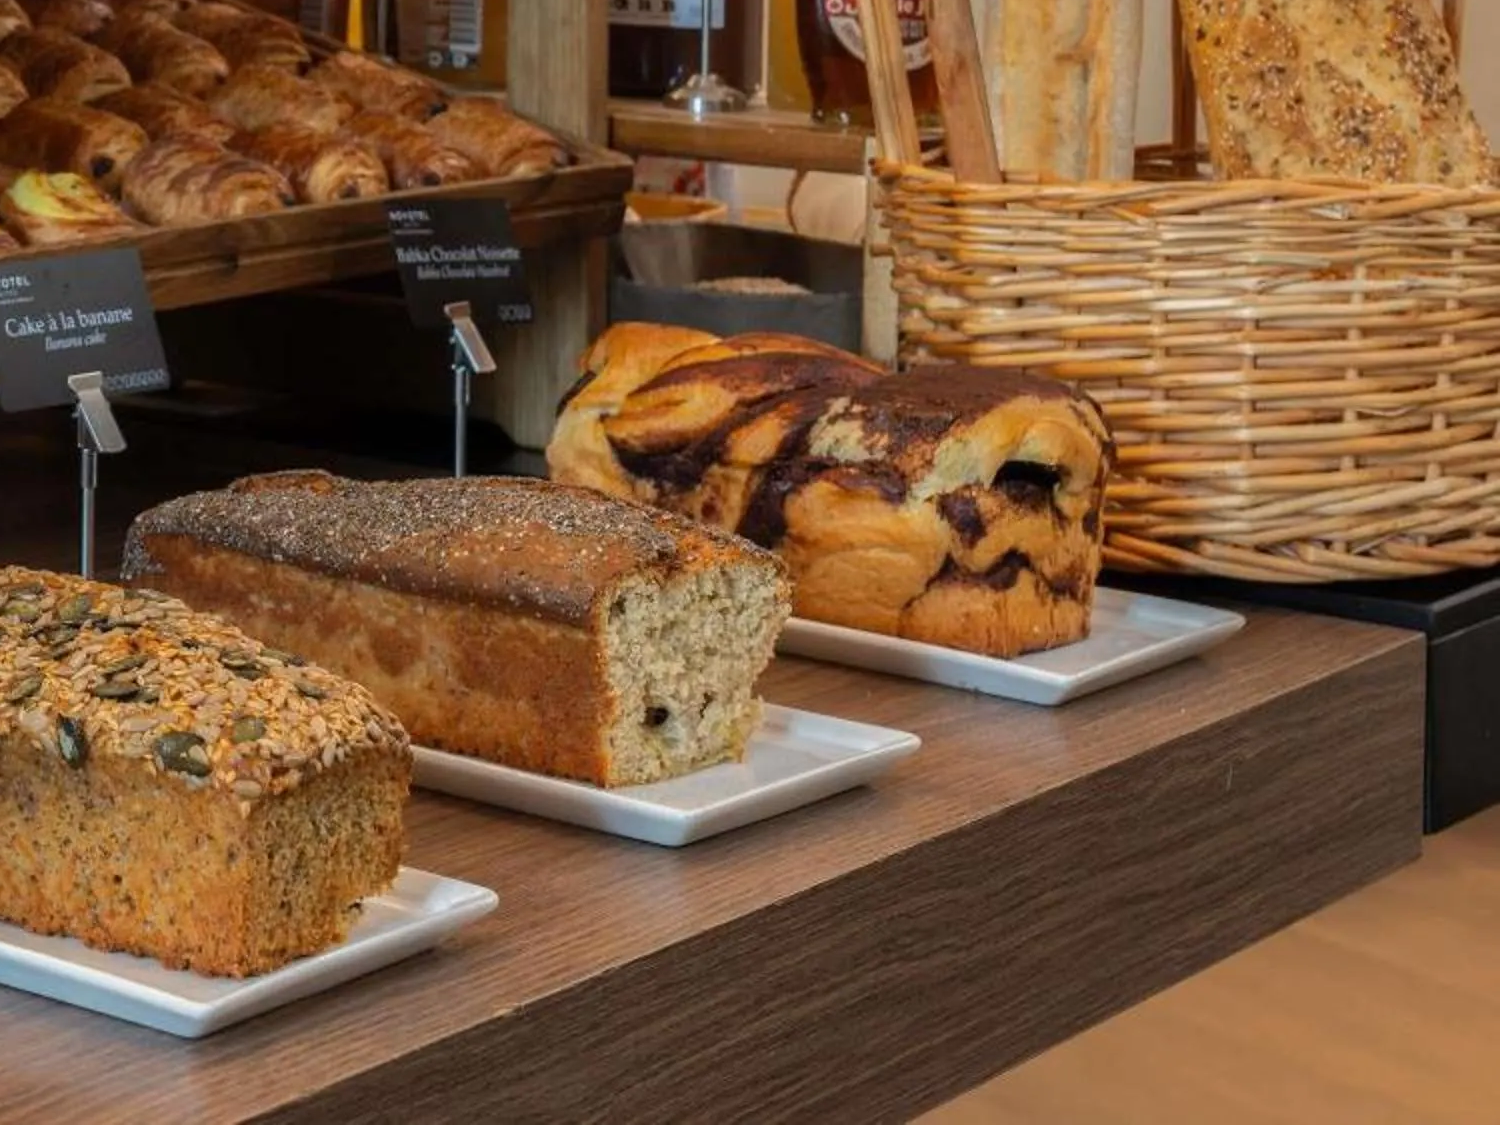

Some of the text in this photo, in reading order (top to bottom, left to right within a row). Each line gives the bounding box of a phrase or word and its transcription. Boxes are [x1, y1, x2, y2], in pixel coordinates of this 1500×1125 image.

[5, 307, 133, 338] Cake à la banane
